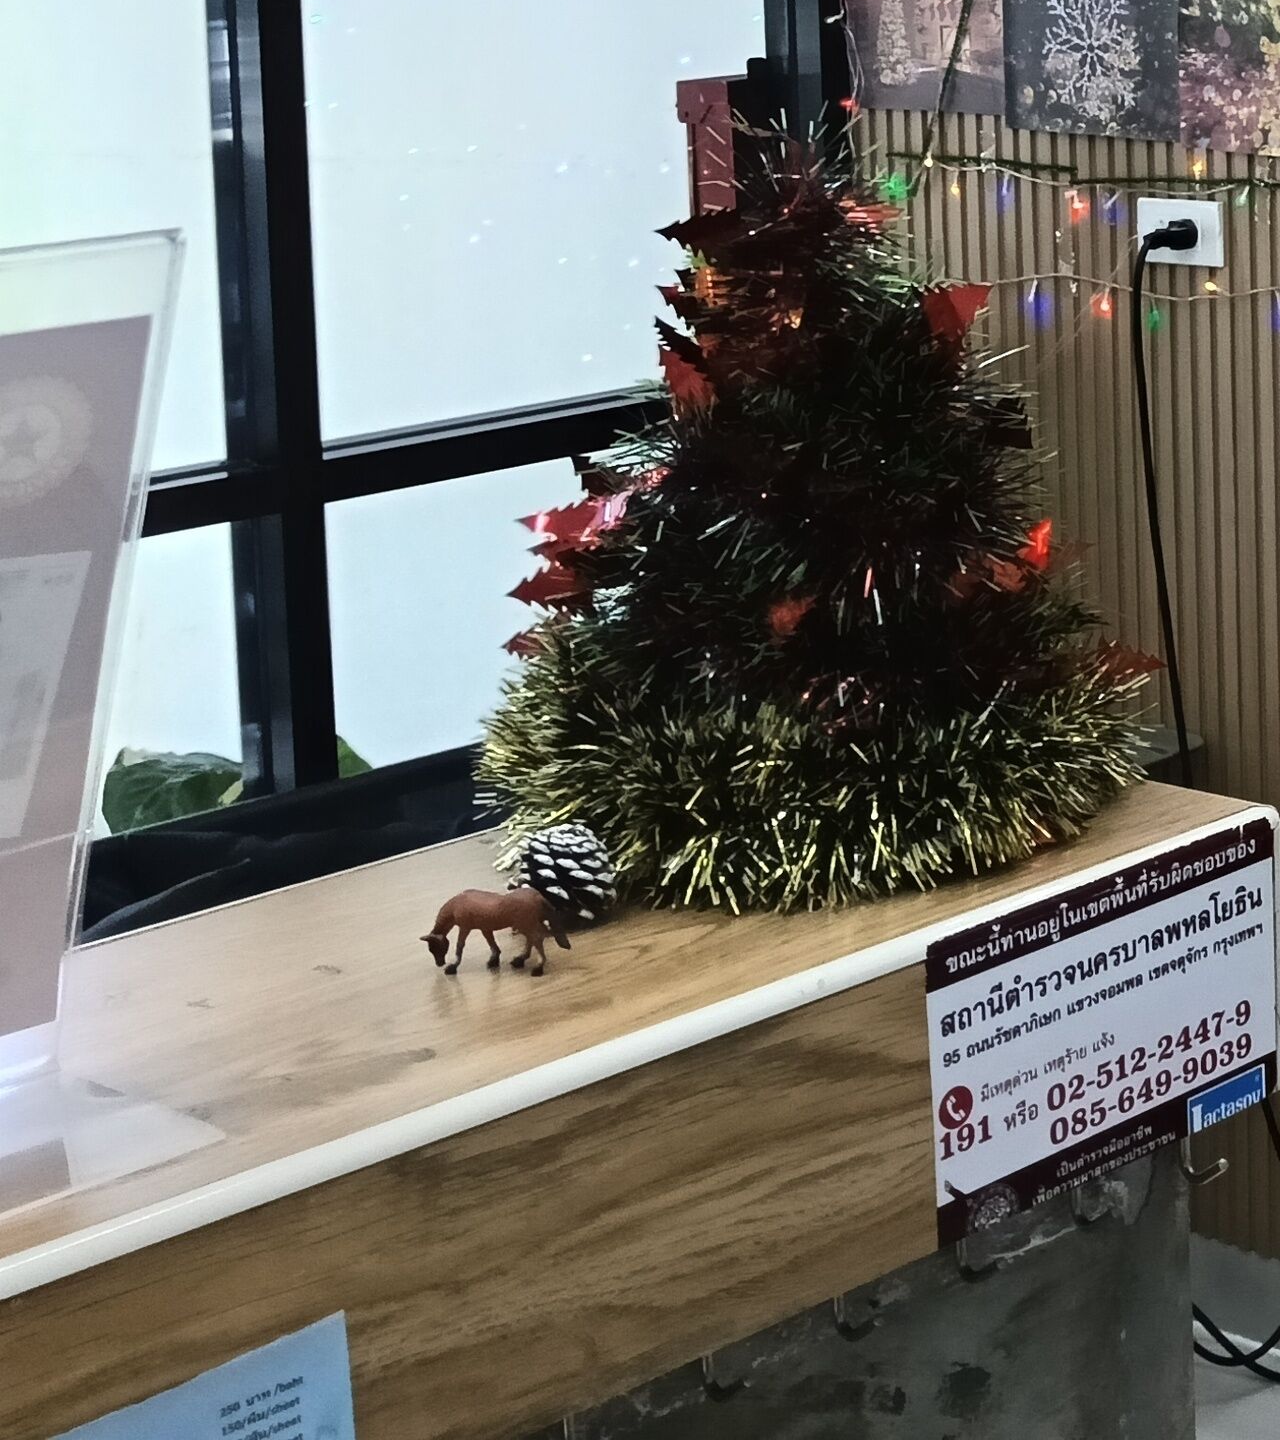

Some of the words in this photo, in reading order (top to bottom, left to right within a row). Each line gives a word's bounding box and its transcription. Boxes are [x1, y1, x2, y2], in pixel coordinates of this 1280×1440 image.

[939, 883, 1264, 1038] สถานีตำรวจนครบาลพหลโยธิน
[945, 837, 1256, 975] ขณะนี้ท่านอยู่ในเขตพื้นที่รับผิดชอบของ
[943, 1049, 961, 1068] 95
[966, 1007, 1062, 1062] ถนนรัชดาภิเษก
[1067, 972, 1144, 1017] แขวงจอมพล
[1148, 943, 1209, 986] เขตจตุจักร
[1212, 923, 1265, 959] กรุงเทพฯ
[938, 1115, 993, 1162] 191
[1003, 1101, 1040, 1133] หรือ
[1046, 998, 1253, 1111] 02-512-2447-9
[979, 1069, 1040, 1105] มีเหตุด่วน
[1043, 1047, 1088, 1082] เหตุร้าย
[1091, 1031, 1117, 1056] แจ้ง
[1049, 1032, 1254, 1145] 085-649-9039
